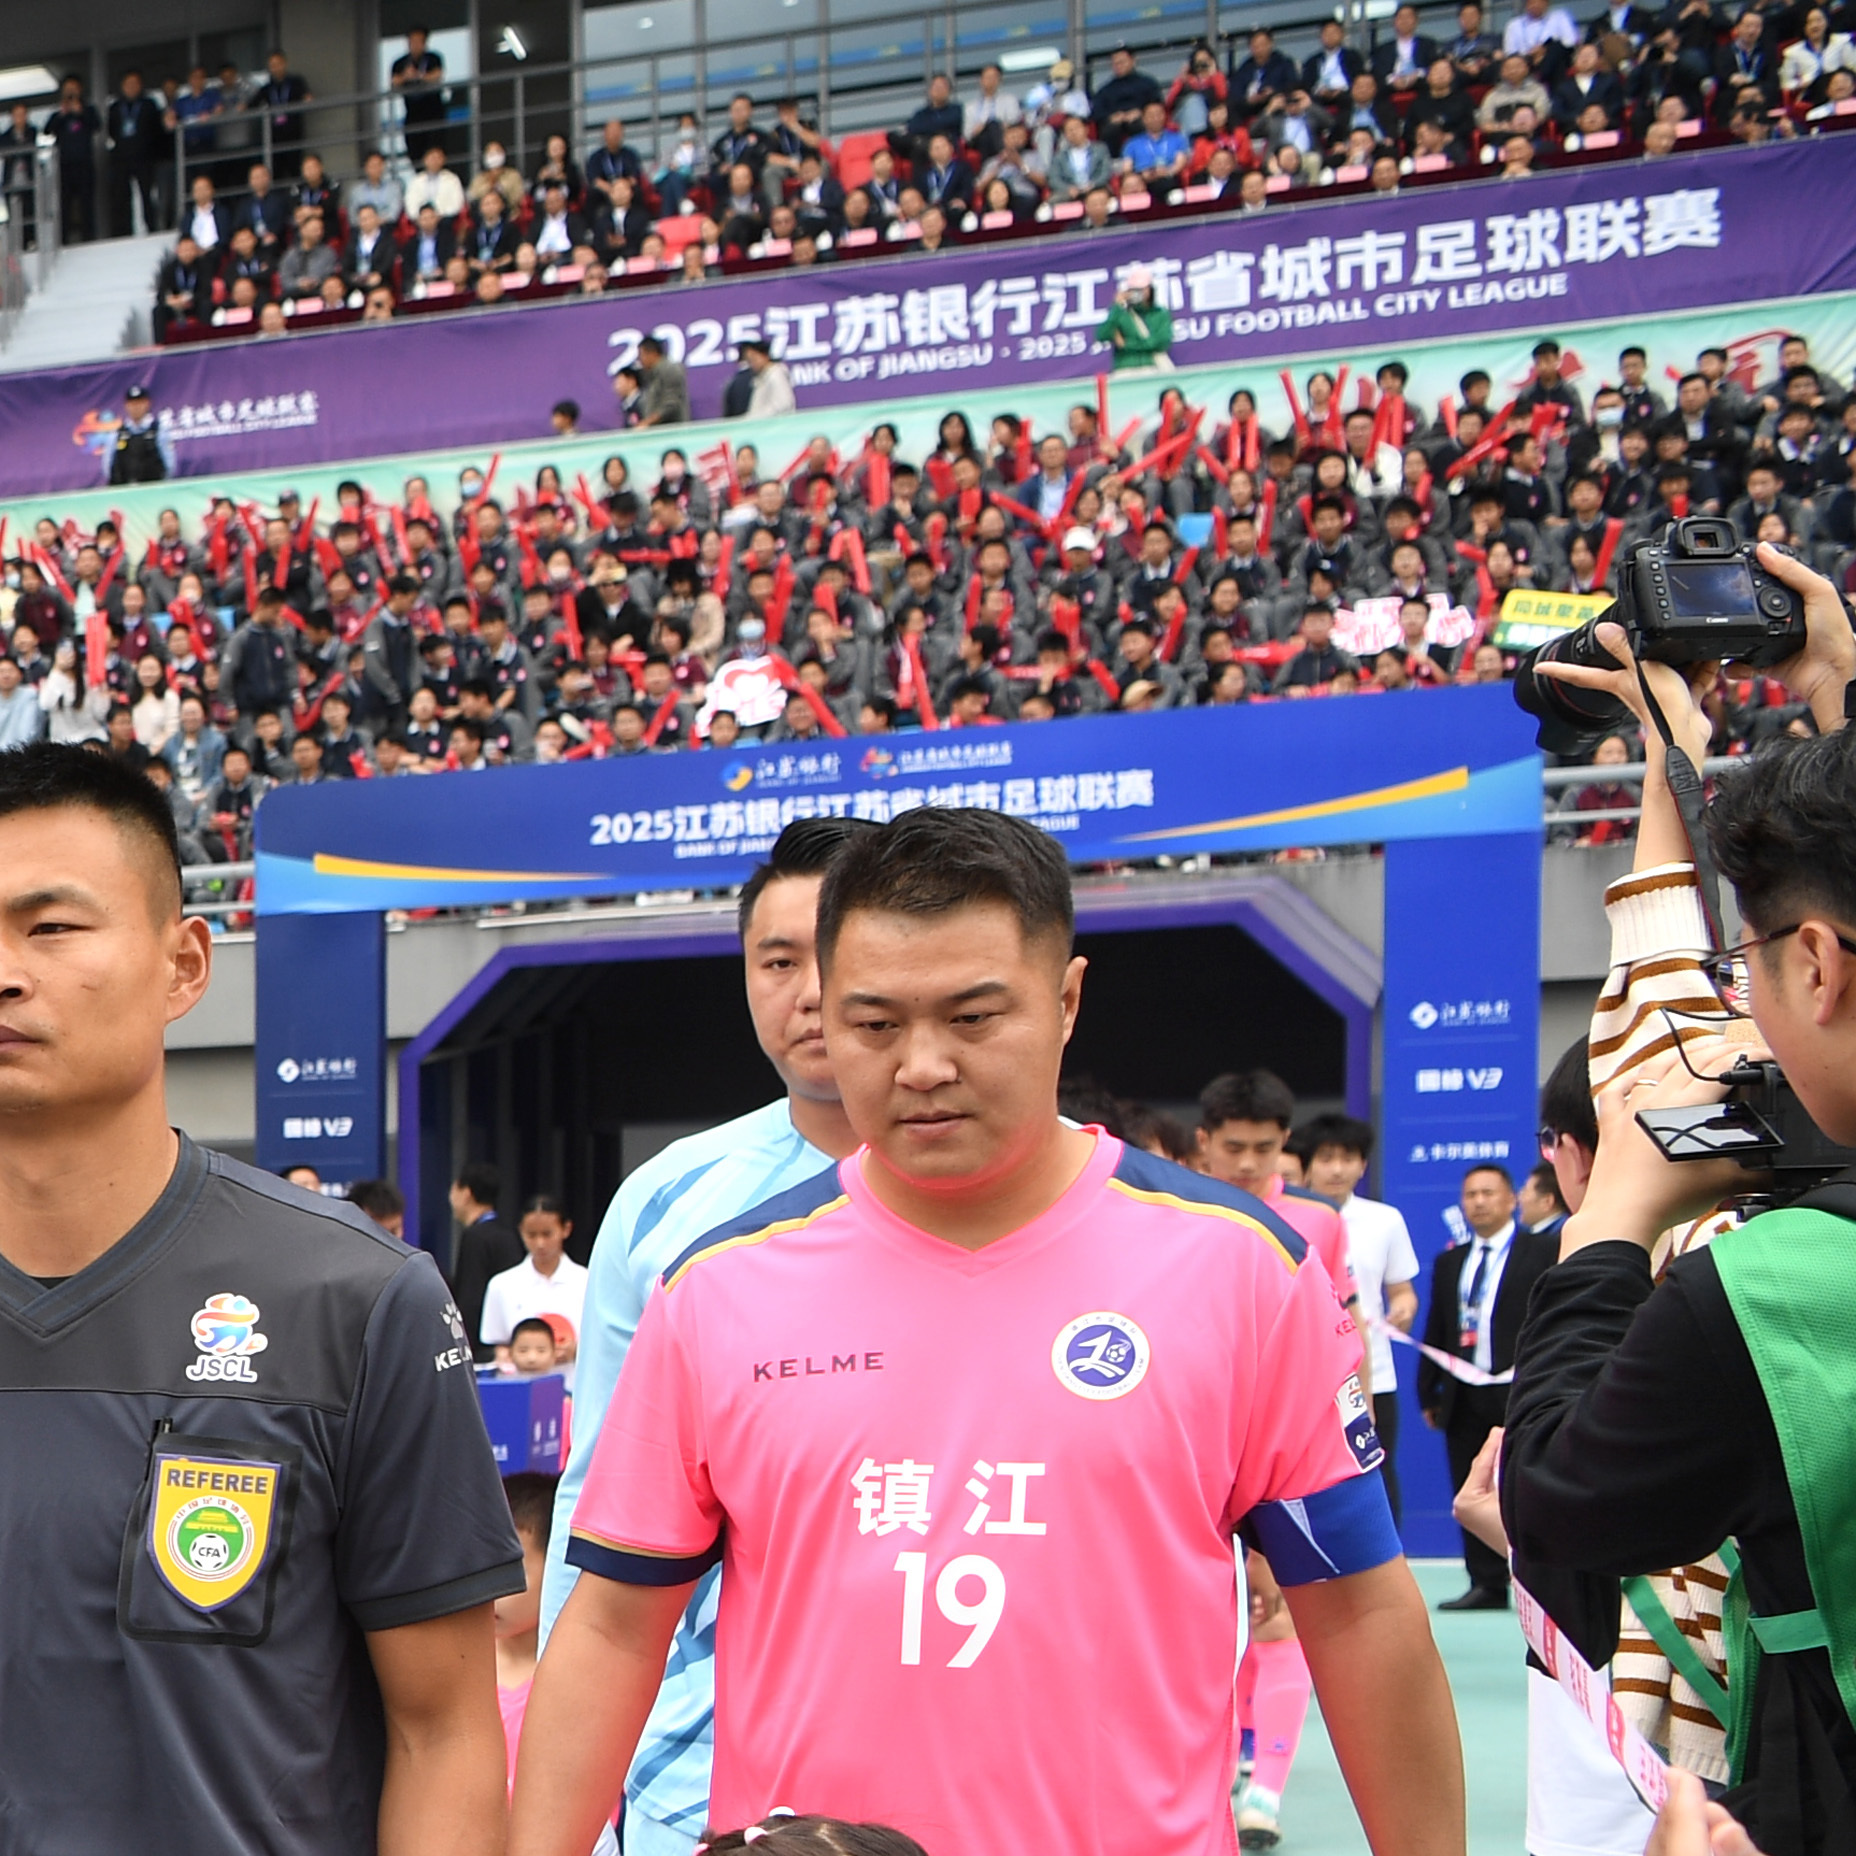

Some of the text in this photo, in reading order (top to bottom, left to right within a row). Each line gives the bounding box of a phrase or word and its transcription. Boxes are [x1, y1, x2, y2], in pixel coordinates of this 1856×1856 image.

[835, 350, 875, 381] OF
[879, 343, 993, 380] JIANGSU
[1019, 332, 1087, 360] 2025
[1218, 297, 1368, 336] FOOTBALL
[1375, 287, 1442, 318] CITY
[1448, 273, 1568, 307] LEAGUE
[187, 1355, 258, 1382] JSCL
[753, 1351, 885, 1383] KELME
[166, 1467, 269, 1495] REFEREE
[851, 1457, 1047, 1537] 镇江
[198, 1546, 221, 1559] CFA
[893, 1551, 1007, 1669] 19
